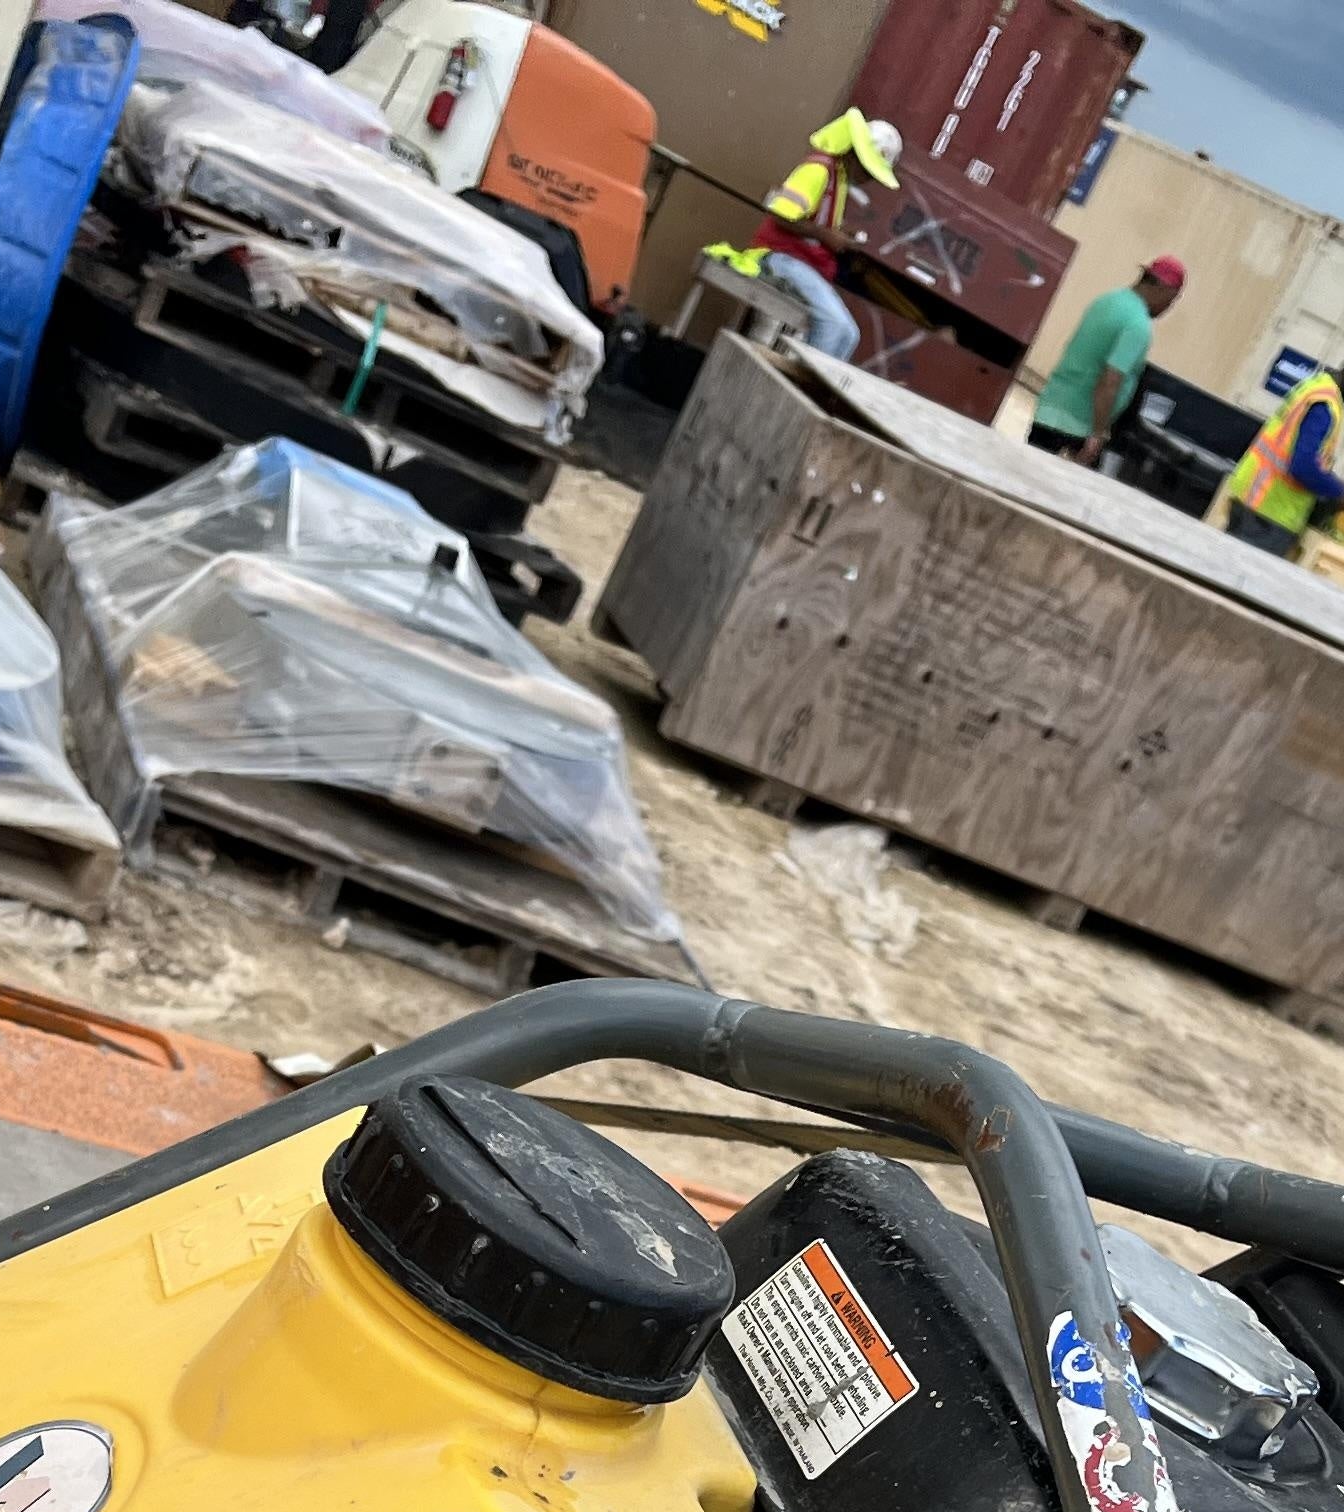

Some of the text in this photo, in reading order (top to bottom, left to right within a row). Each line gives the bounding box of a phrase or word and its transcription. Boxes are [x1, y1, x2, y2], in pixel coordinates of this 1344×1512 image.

[735, 1309, 751, 1328] Read
[745, 1324, 767, 1353] Owner's
[759, 1349, 780, 1377] Manual
[773, 1372, 792, 1398] before
[750, 1296, 762, 1310] Do
[756, 1306, 768, 1322] not
[762, 1318, 775, 1333] run
[774, 1337, 784, 1350] an
[779, 1346, 804, 1380] enclosed
[762, 1284, 849, 1420] The engine emits toxic carbon mooxide.
[778, 1271, 793, 1290] Turn
[786, 1286, 806, 1312] engine
[800, 1307, 812, 1321] off
[806, 1317, 821, 1335] and
[814, 1330, 827, 1345] let
[821, 1340, 837, 1360] cool
[845, 1382, 872, 1418] efueling.
[791, 1260, 814, 1291] Gasoline
[810, 1293, 830, 1319] highly
[824, 1313, 853, 1353] flammable
[847, 1349, 862, 1368] and
[855, 1363, 884, 1403] eplosive.
[840, 1299, 876, 1350] WARNING
[794, 1444, 815, 1474] THAILAND
